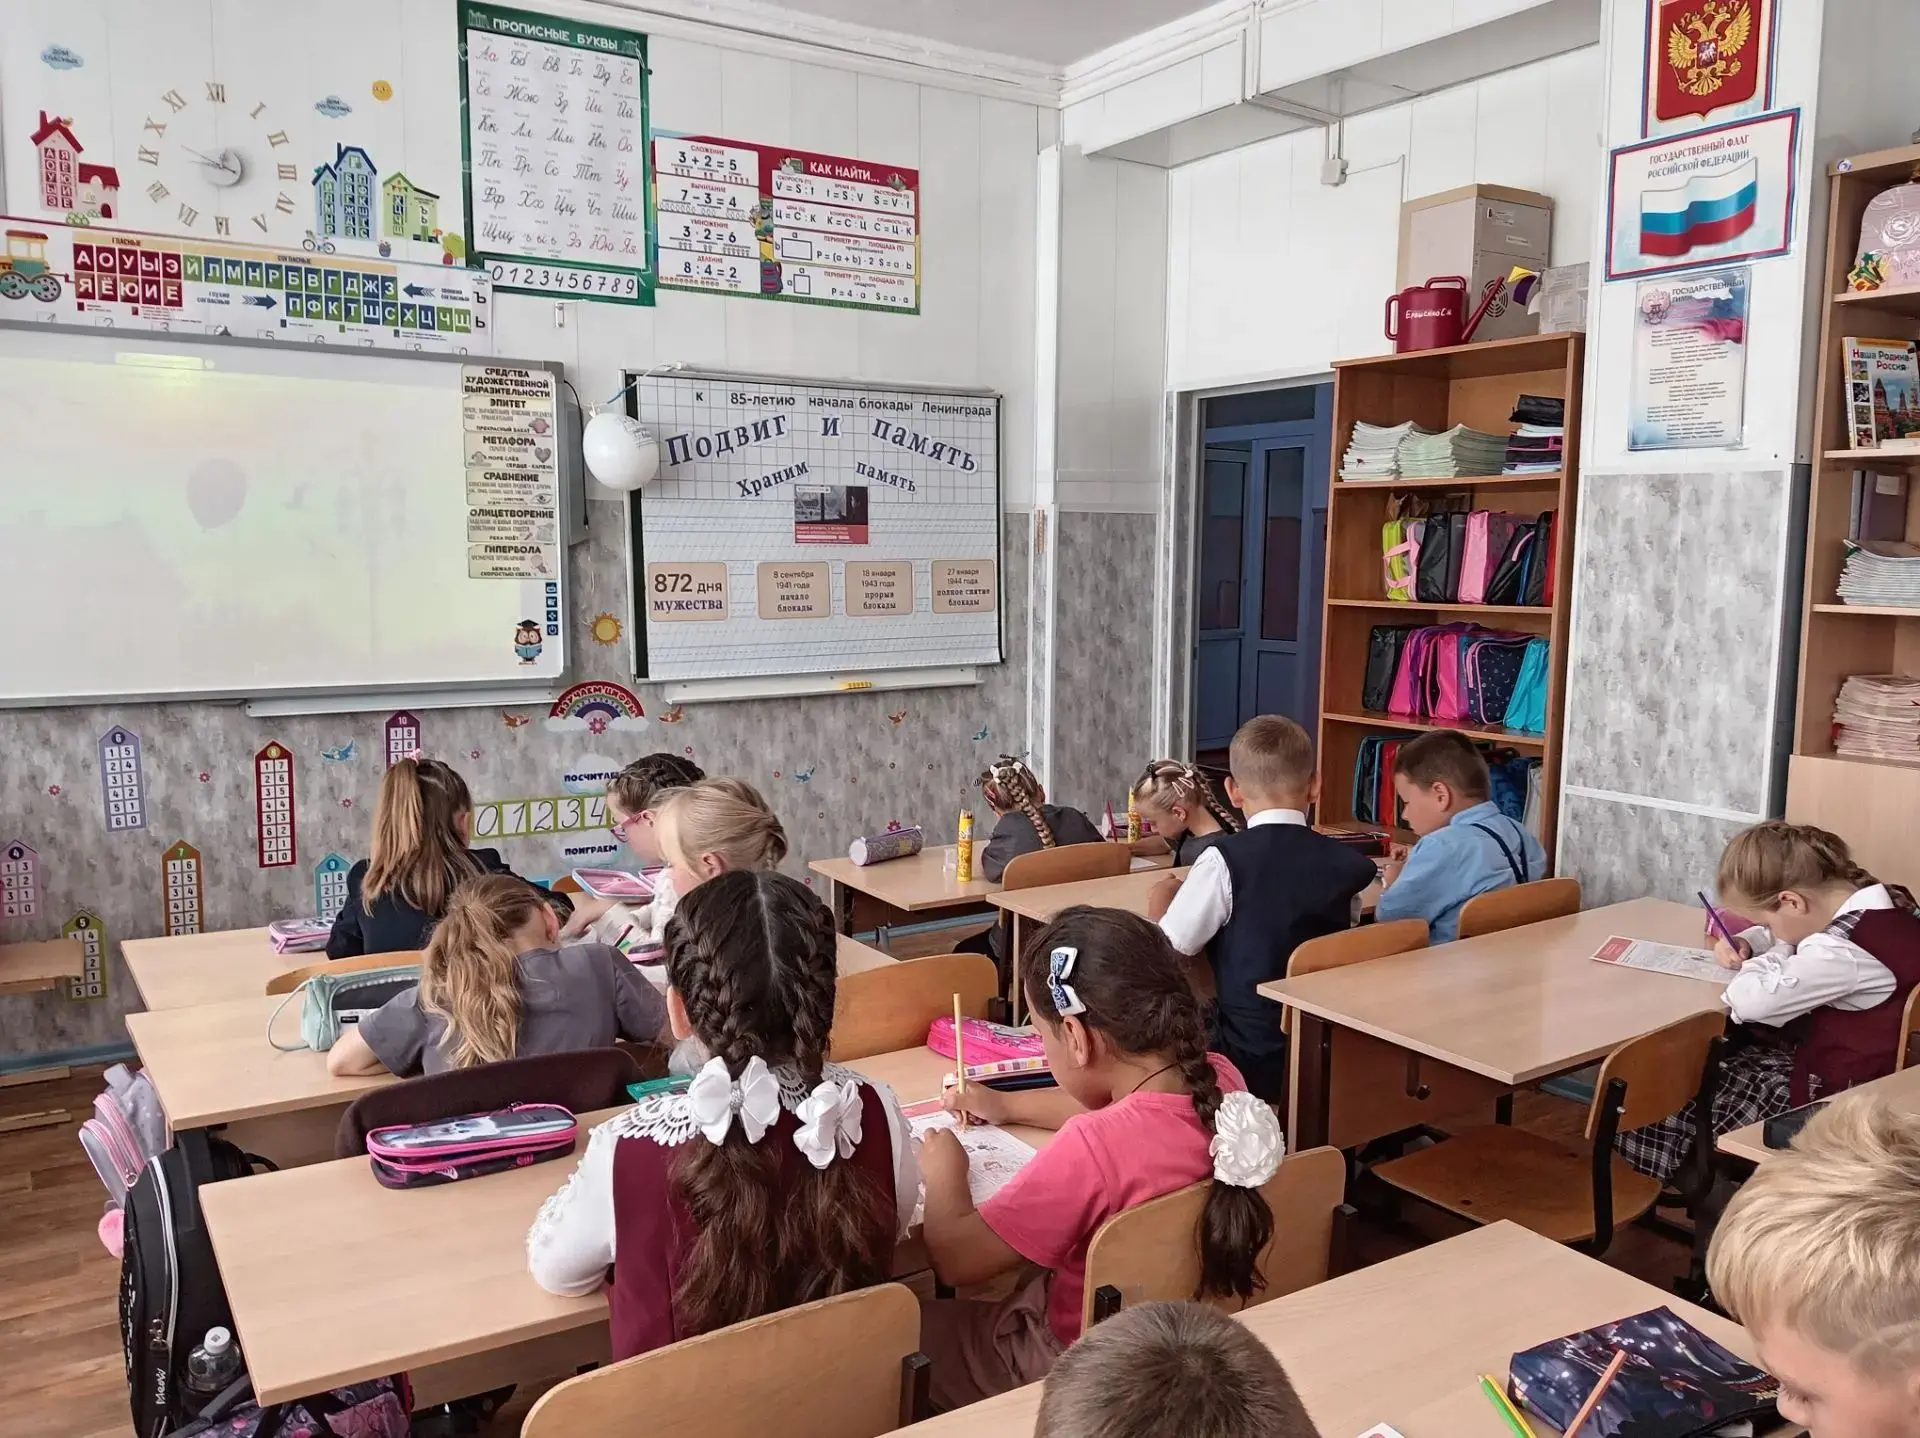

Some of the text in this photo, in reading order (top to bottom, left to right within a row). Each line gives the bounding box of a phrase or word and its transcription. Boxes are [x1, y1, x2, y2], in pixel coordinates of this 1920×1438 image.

[493, 18, 617, 50] ПРОПИСНЫЕ БУКВЫ
[690, 145, 724, 156] СЛОЖЕНИЕ
[1649, 134, 1750, 165] ГОСУДАРСТВЕННЫЙ ФЛАГ
[810, 162, 832, 176] КАК
[1647, 149, 1749, 179] РОССИЙСКОЙ ФЕДЕРАЦИИ
[77, 251, 395, 295] А О У Ы Э Й Л М Н Р Б В Г Д Ж З
[79, 278, 179, 300] Я Ё Ю И Е
[1672, 279, 1745, 295] ГОСУДАРСТВЕННЫЙ
[289, 297, 471, 328] П Ф К Т Ш С Х Ц Ч Щ
[1853, 348, 1877, 359] Наша
[1876, 361, 1907, 371] Россия
[485, 368, 529, 378] СРЕДСТВА
[465, 376, 549, 388] ХУДОЖЕСТВЕННОЙ
[464, 386, 550, 398] ВЫРАЗИТЕЛЬНОСТИ
[490, 398, 526, 408] ЭПИТЕТ
[730, 392, 795, 406] 85-летию
[809, 397, 854, 409] начала
[859, 397, 913, 411] блокады
[922, 402, 992, 417] Ленинграда
[483, 436, 536, 446] МЕТАФОРА
[665, 414, 786, 466] Подвиг
[872, 418, 976, 471] память
[484, 472, 539, 482] СРАВНЕНИЕ
[736, 461, 917, 497] Храним память
[470, 509, 554, 519] ОЛИЦЕТВОРЕНИЕ
[484, 545, 541, 554] ГИПЕРБОЛА
[780, 571, 814, 579] сентября
[654, 573, 722, 594] 872 дня
[776, 581, 792, 589] 1941
[780, 593, 809, 601] начало
[865, 592, 895, 600] прорыв
[653, 599, 723, 614] мужества
[777, 604, 813, 612] блокады
[557, 685, 602, 715] ИЗУЧАЕМ
[605, 686, 637, 714] ЦИФРЫ
[398, 716, 408, 725] 10
[564, 772, 619, 782] ПОСЧИТАЕ
[534, 801, 553, 832] 2
[562, 799, 580, 828] 3
[565, 845, 617, 855] ПОИГРАЕМ
